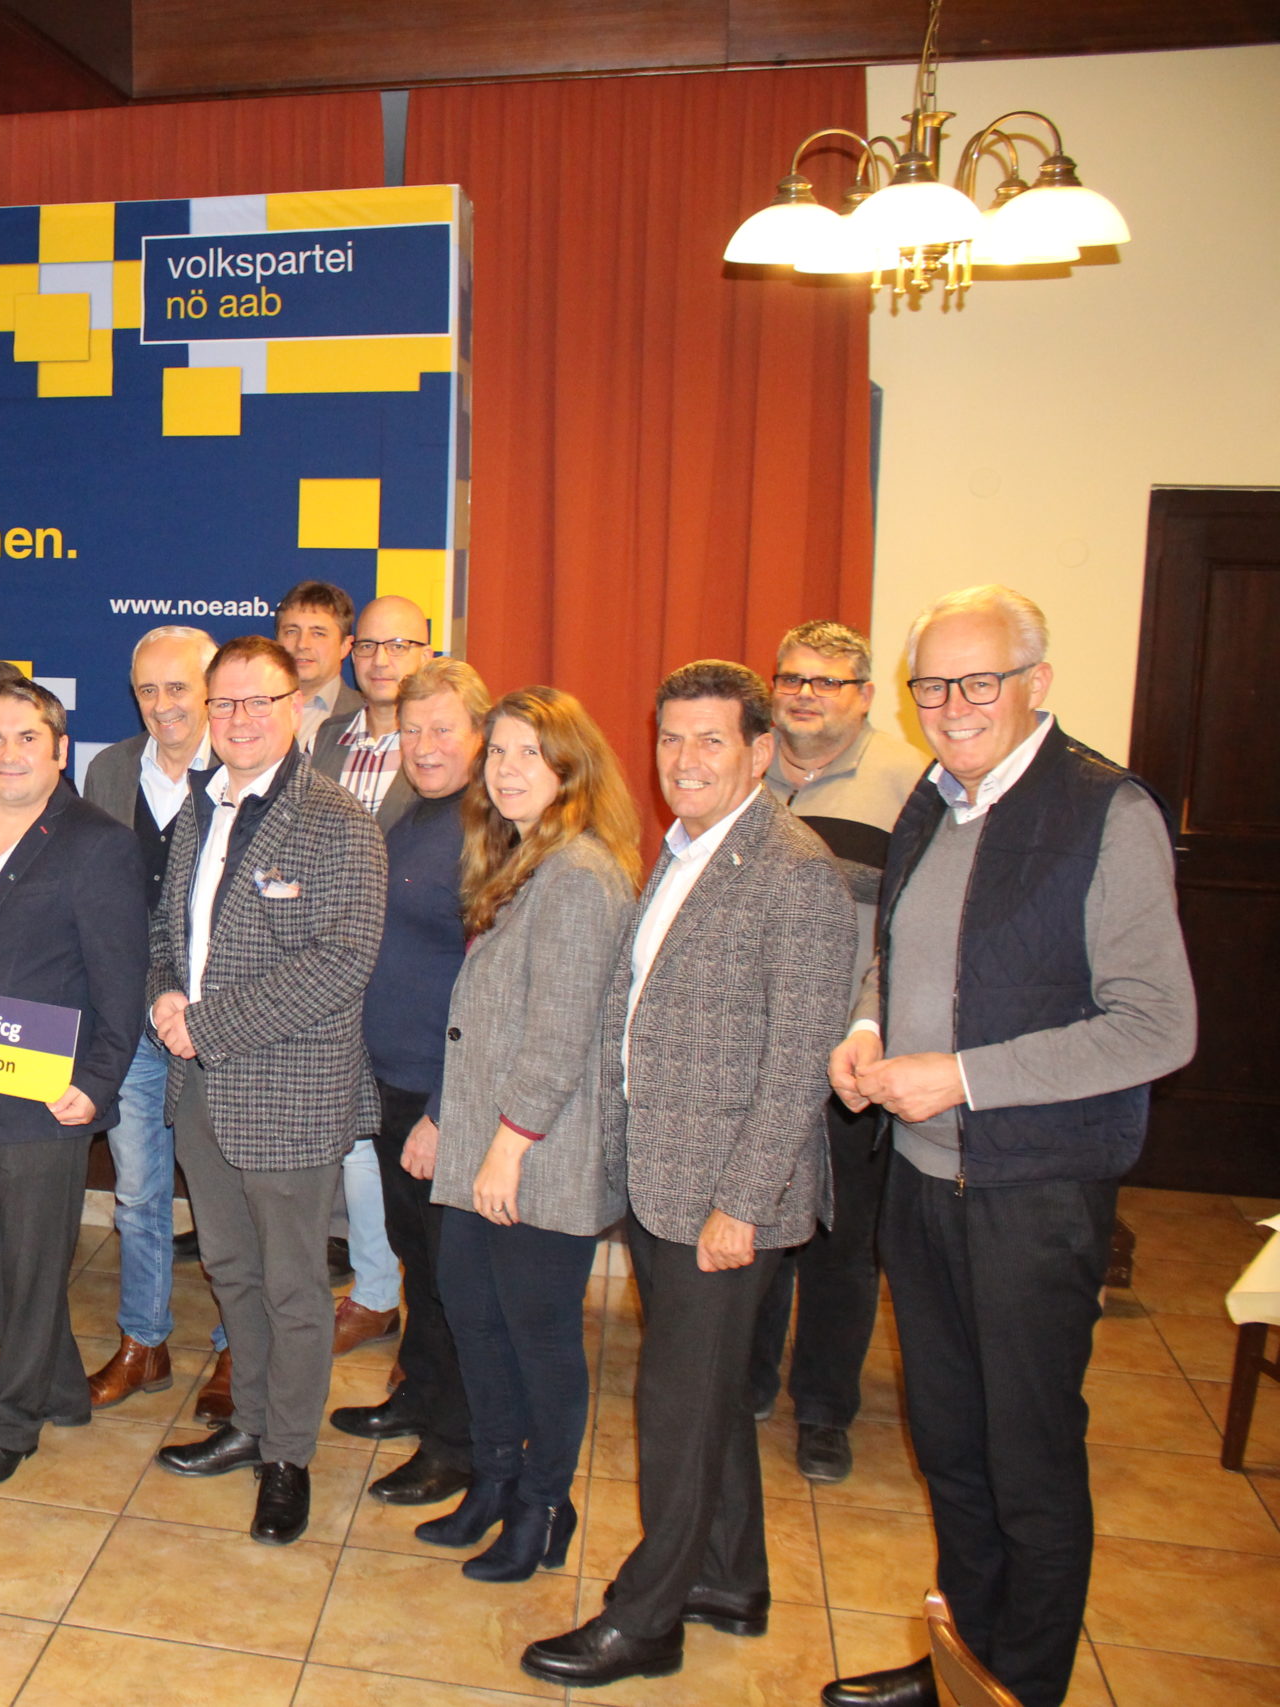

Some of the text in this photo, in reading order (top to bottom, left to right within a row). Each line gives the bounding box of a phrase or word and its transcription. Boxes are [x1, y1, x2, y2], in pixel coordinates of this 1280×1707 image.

[167, 240, 353, 284] volkspartei
[166, 286, 282, 319] nö aab
[109, 597, 282, 617] www.noeaab.
